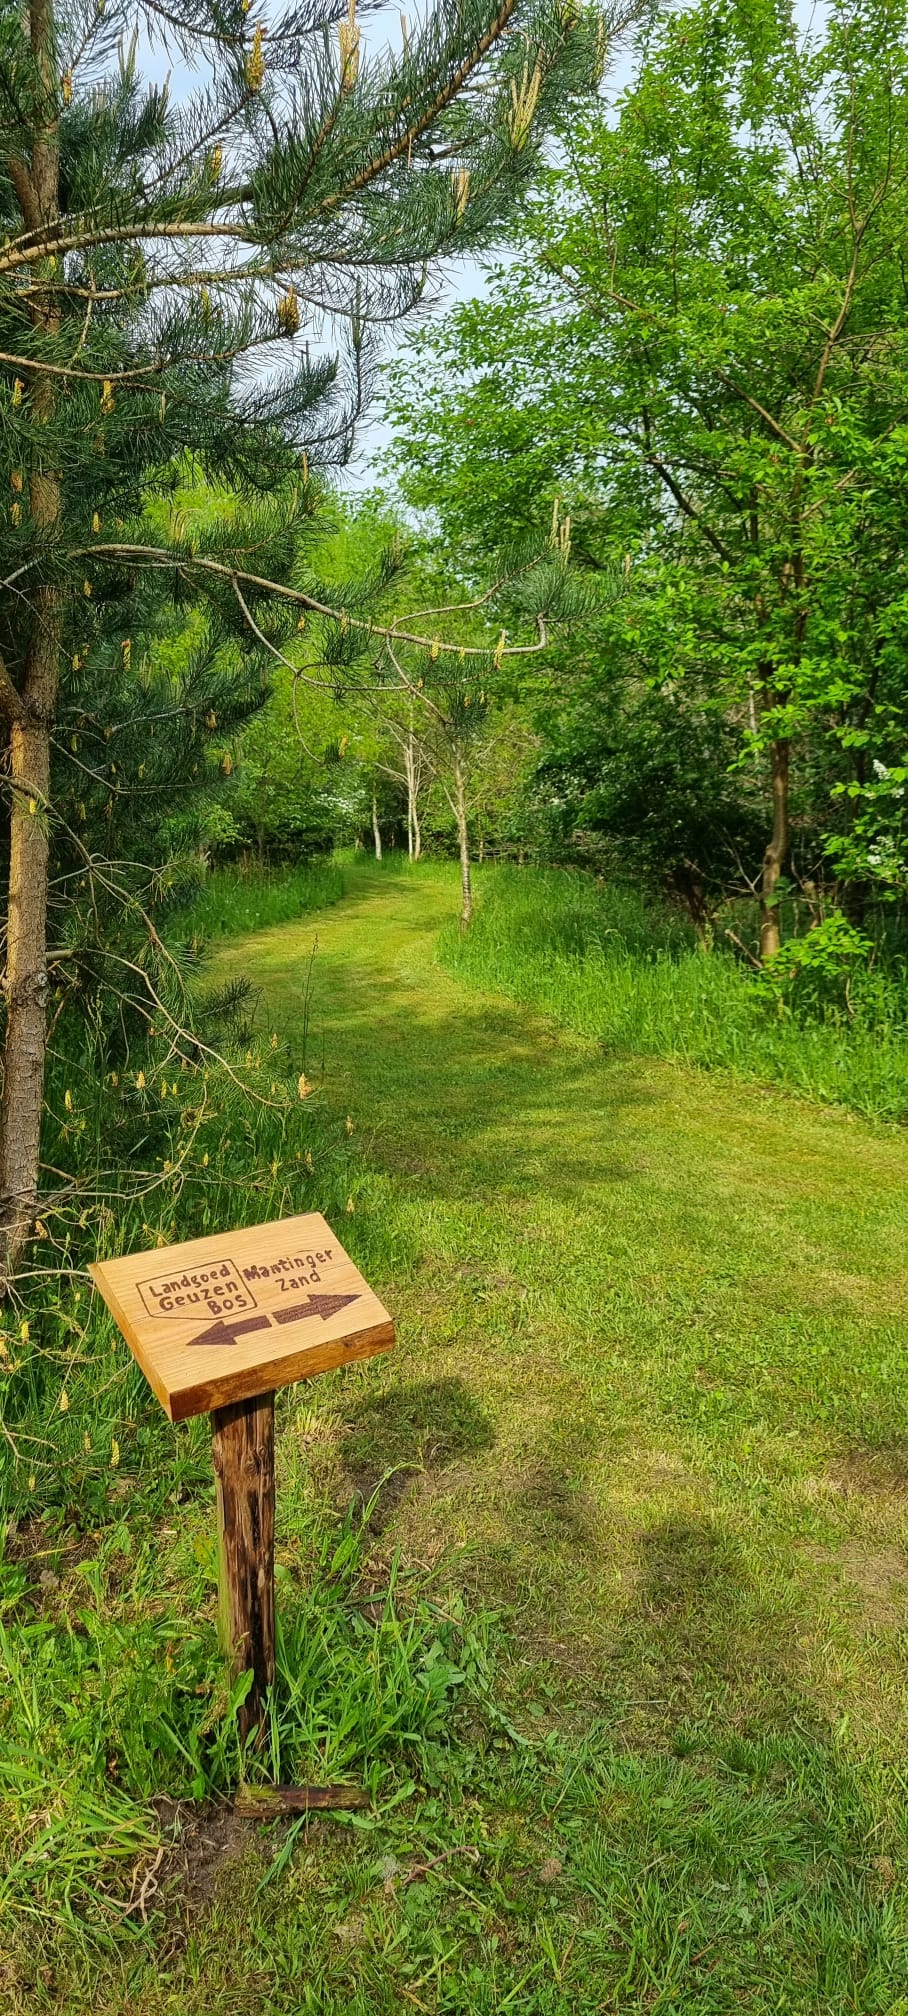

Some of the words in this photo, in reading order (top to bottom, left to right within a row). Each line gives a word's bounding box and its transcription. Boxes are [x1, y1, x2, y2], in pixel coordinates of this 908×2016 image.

[242, 1248, 333, 1281] Mantinger
[275, 1269, 321, 1292] Zand
[149, 1264, 231, 1298] Landgoed
[158, 1280, 239, 1311] Geuzen
